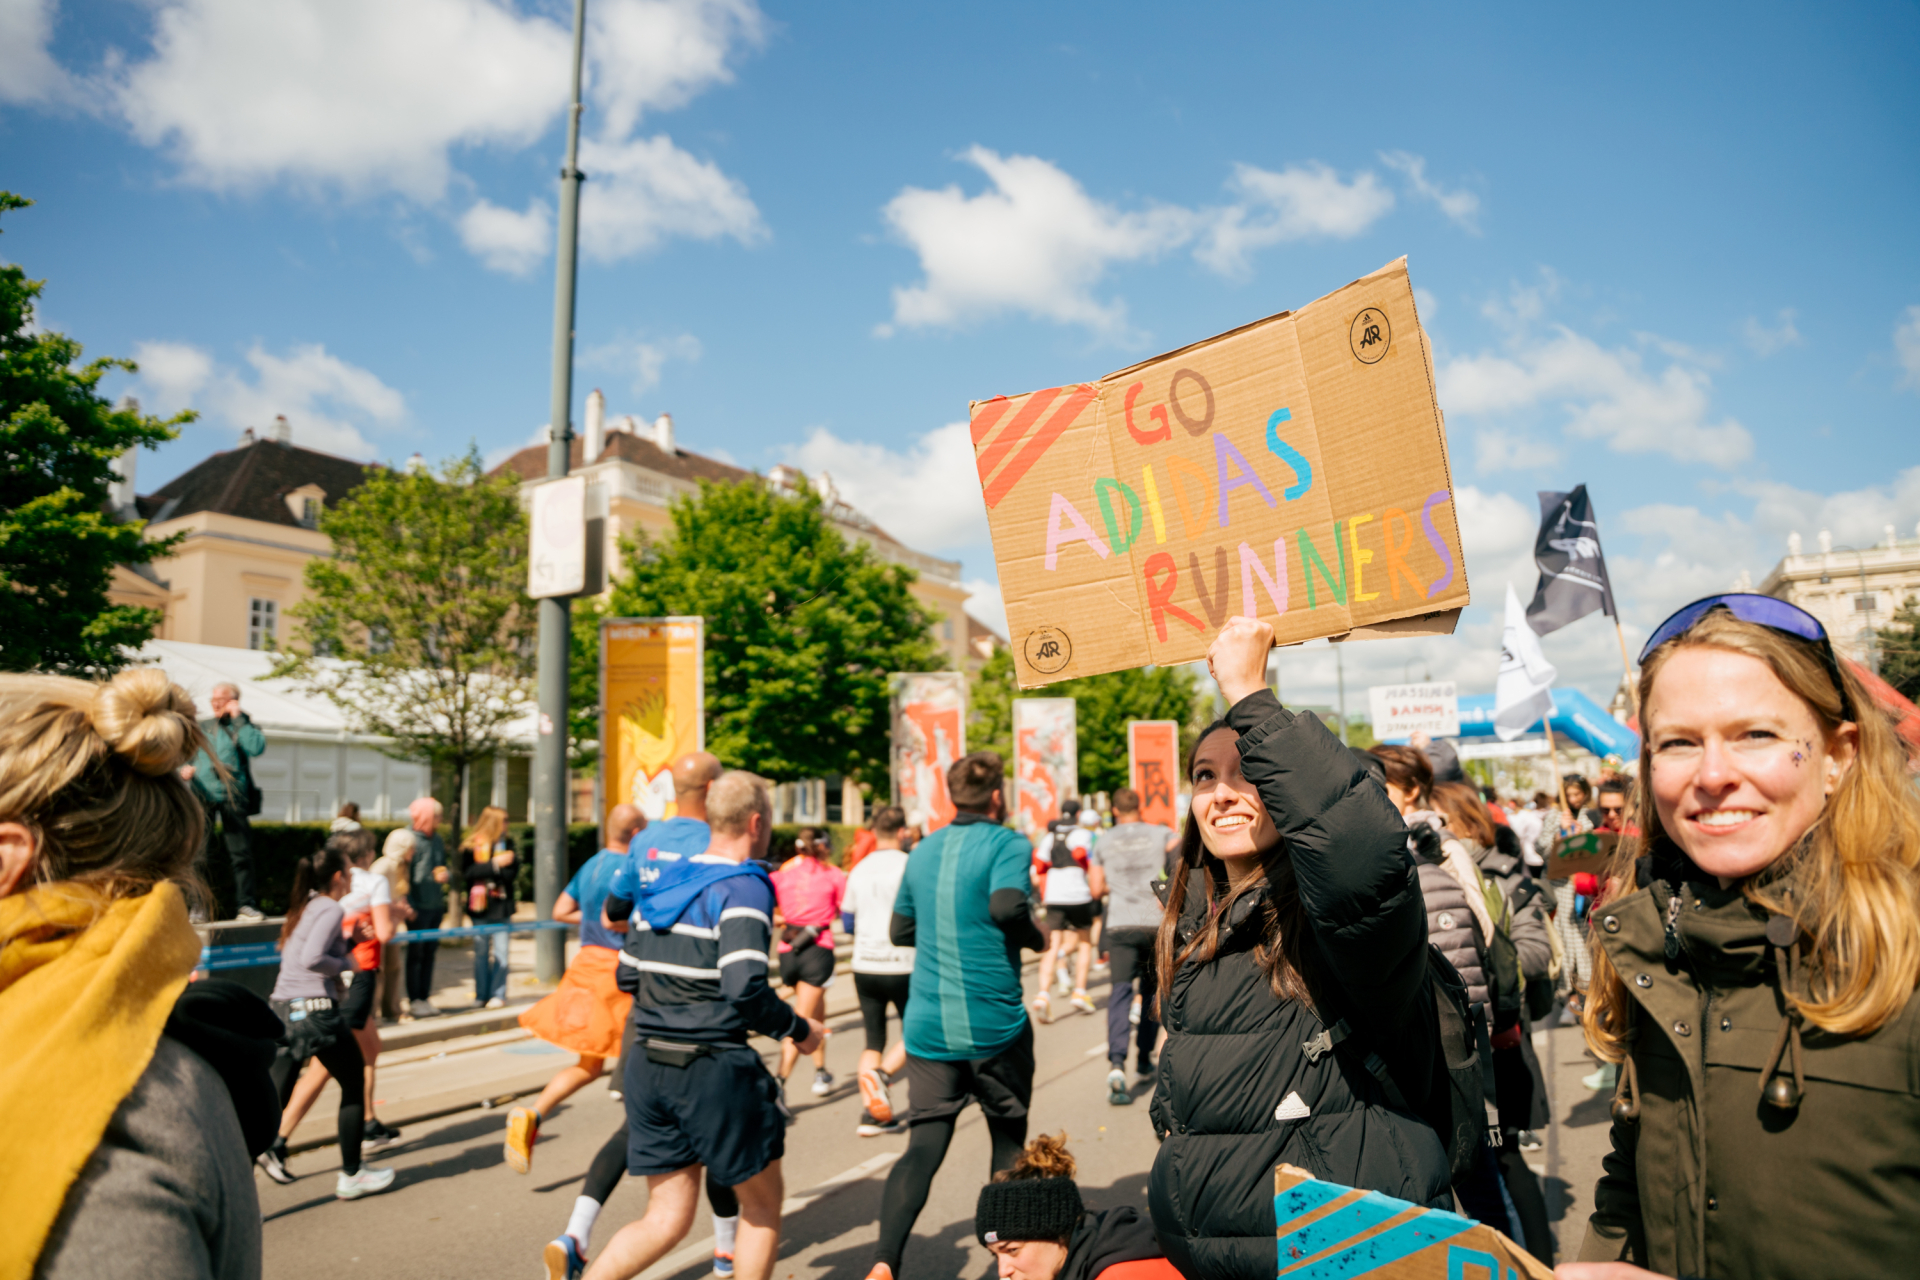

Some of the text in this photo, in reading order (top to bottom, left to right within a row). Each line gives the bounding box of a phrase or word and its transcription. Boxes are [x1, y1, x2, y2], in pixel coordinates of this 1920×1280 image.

[1124, 368, 1215, 446] GO
[1044, 407, 1312, 572] ADIDAS
[1143, 490, 1454, 643] RUNNERS
[1391, 705, 1444, 717] DANISH
